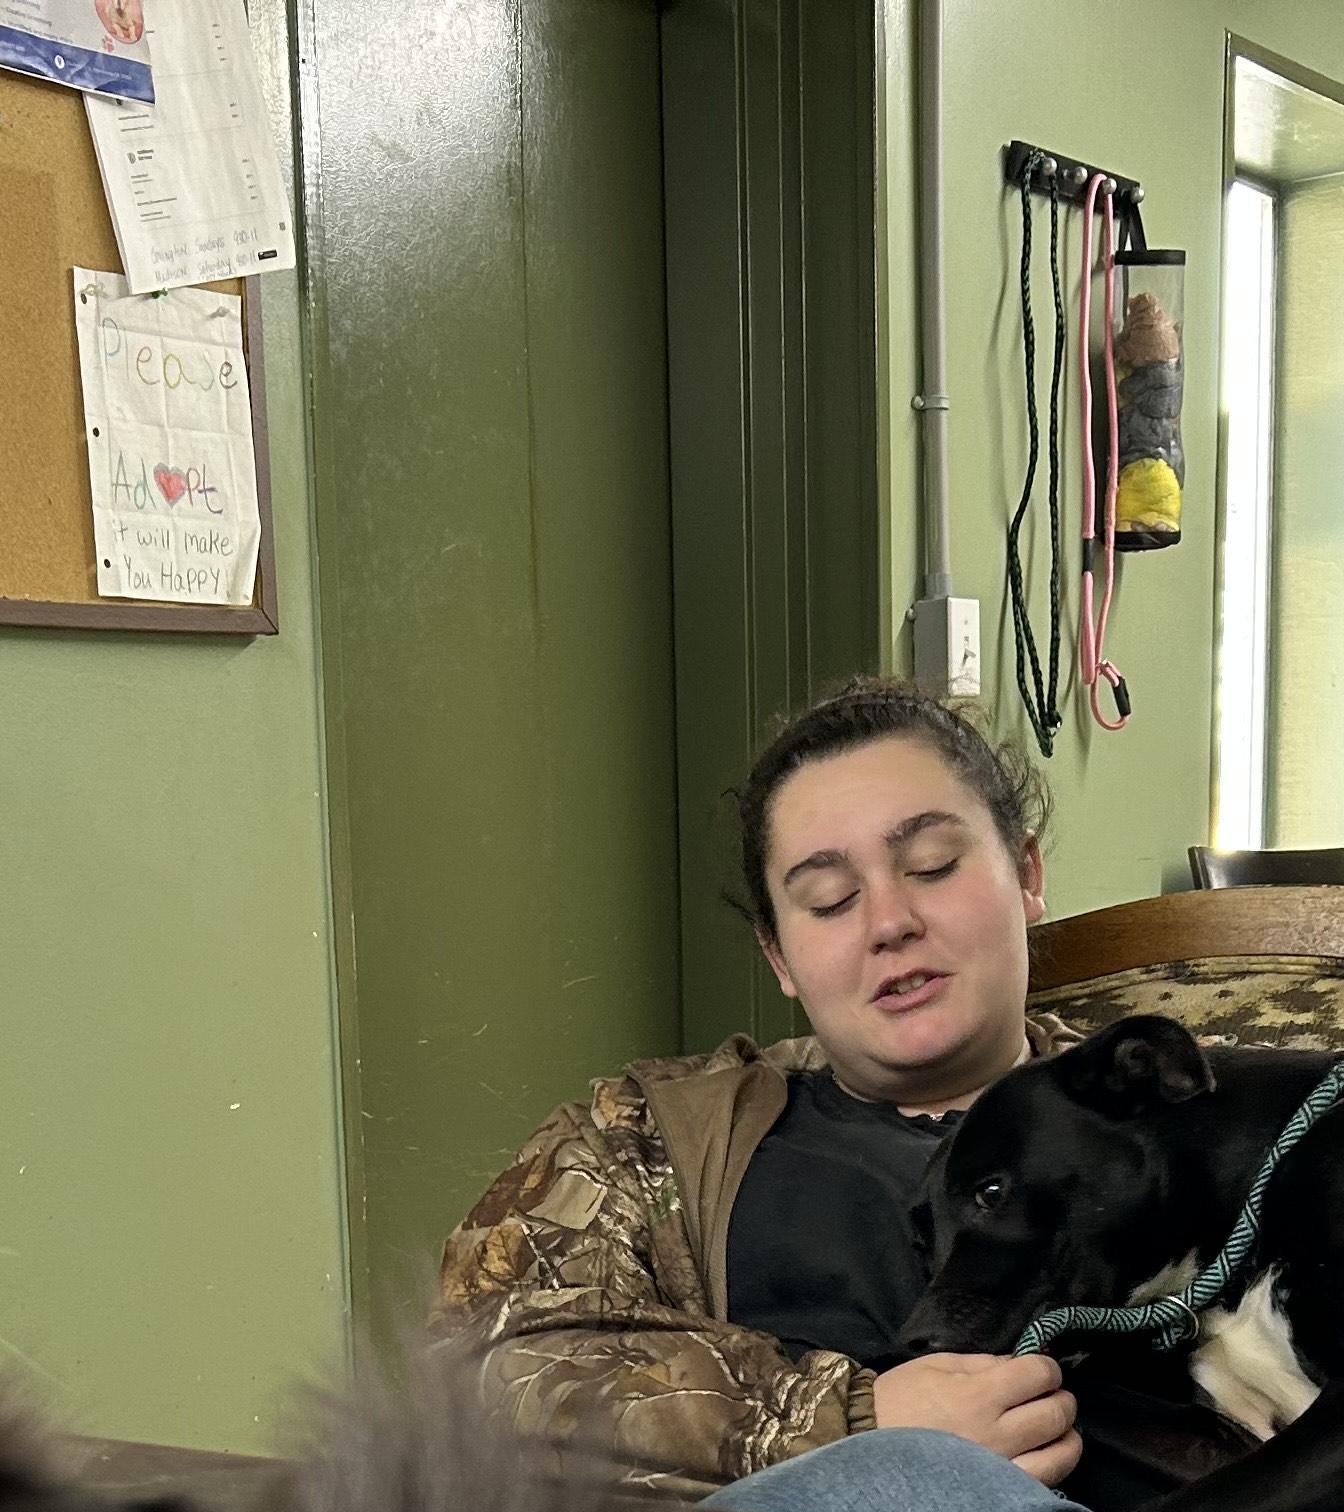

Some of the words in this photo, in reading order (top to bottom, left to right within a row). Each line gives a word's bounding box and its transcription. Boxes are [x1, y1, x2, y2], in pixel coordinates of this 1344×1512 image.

[113, 519, 128, 541] it
[136, 529, 170, 548] will
[184, 527, 233, 556] make
[124, 554, 152, 589] You
